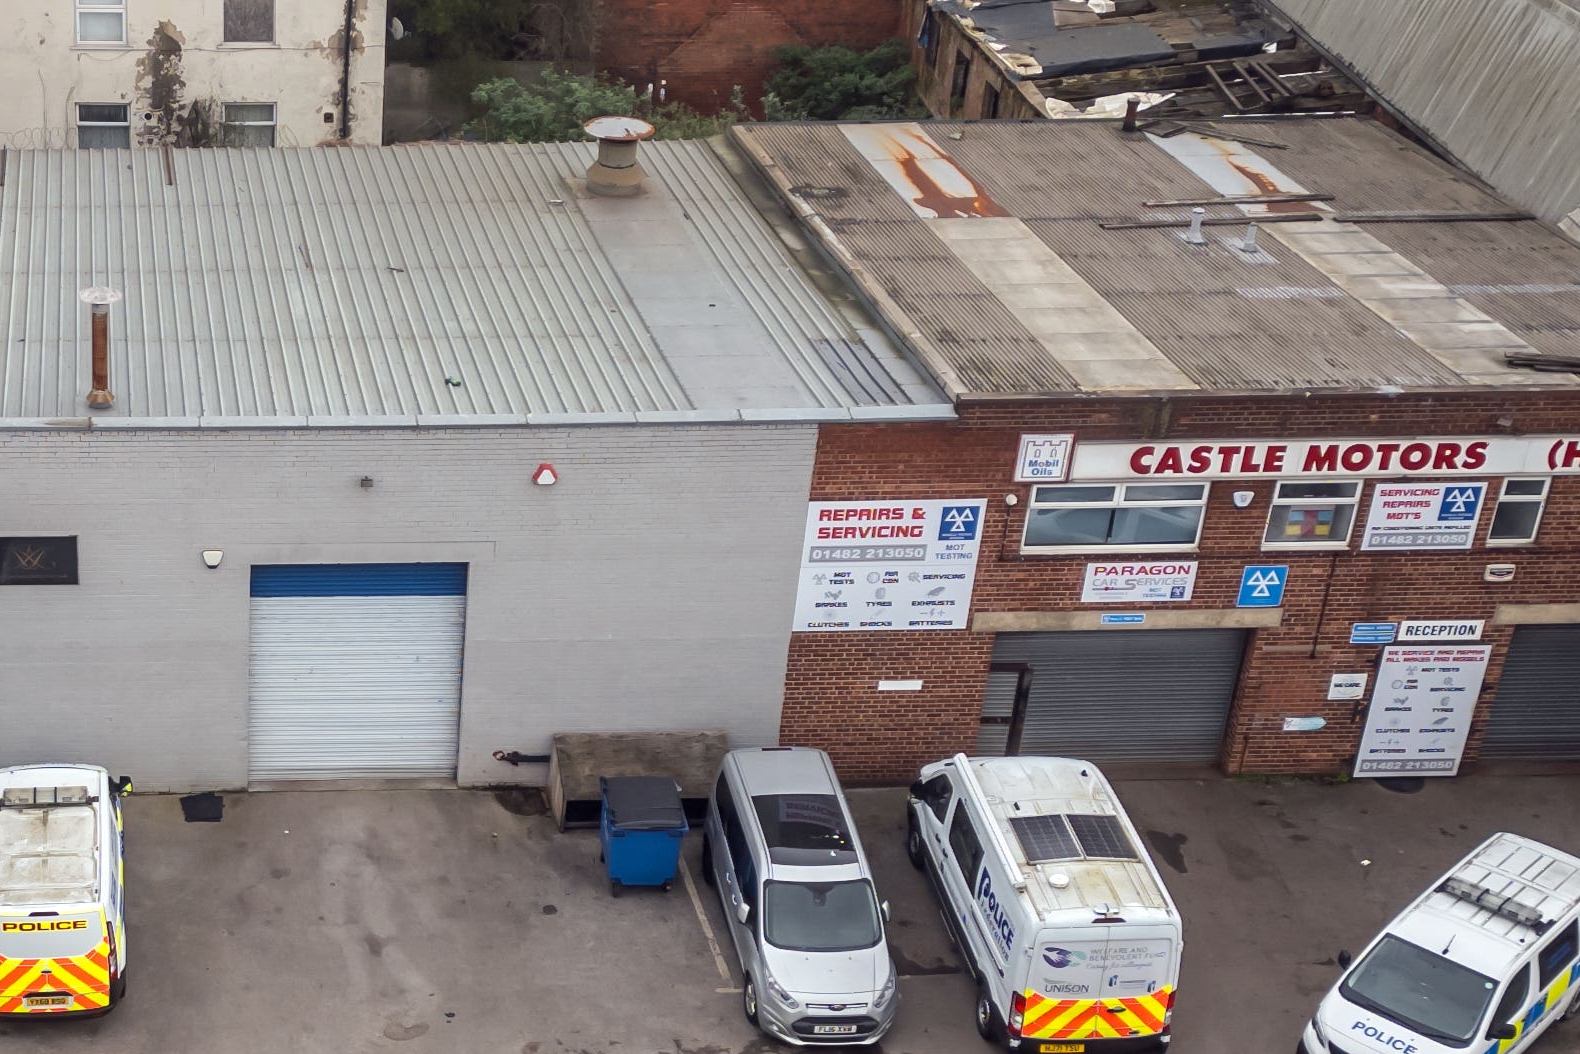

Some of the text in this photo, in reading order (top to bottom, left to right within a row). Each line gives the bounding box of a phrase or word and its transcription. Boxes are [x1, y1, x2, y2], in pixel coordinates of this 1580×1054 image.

[1028, 459, 1060, 468] Mobil
[1129, 445, 1288, 475] CASTLE
[1301, 441, 1490, 472] MOTORS
[1031, 468, 1053, 476] Oils
[1379, 488, 1441, 497] SERVICING
[1382, 500, 1431, 509] REPAIRS
[818, 507, 926, 522] REPAIRS &
[1386, 512, 1422, 520] MOT'S
[817, 525, 924, 539] SERVICING
[1371, 534, 1466, 545] 01482 213050
[812, 548, 924, 560] 01482 213050
[935, 552, 973, 560] TESTING
[1094, 565, 1191, 576] PARAGON
[1092, 577, 1188, 590] CAR SERVICES
[1405, 625, 1478, 636] RECEPTION
[1362, 761, 1454, 770] 01482 213050
[978, 866, 1014, 951] POLICE
[2, 920, 88, 931] POLICE
[1044, 984, 1090, 993] UNISON
